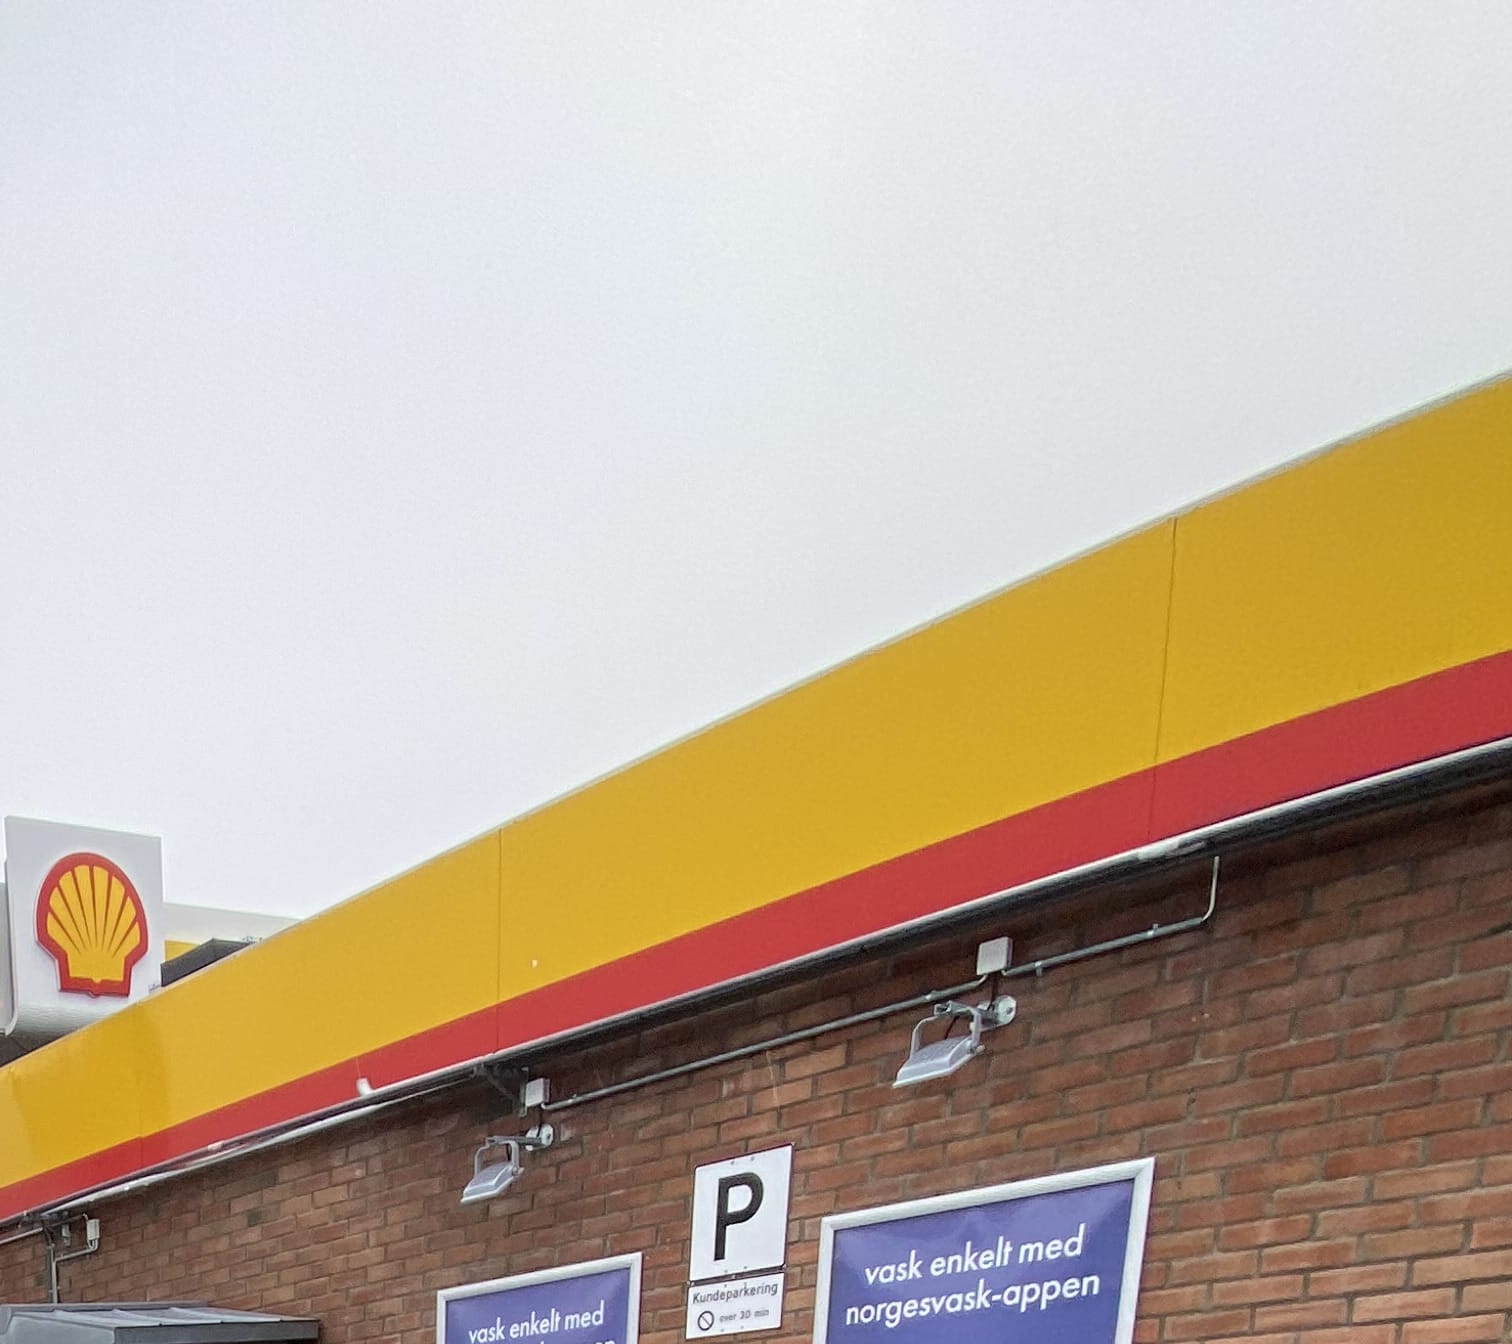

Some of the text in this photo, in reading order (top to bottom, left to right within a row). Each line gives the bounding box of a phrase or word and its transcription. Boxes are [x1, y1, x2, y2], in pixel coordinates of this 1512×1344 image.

[713, 1172, 764, 1261] P
[864, 1223, 1087, 1286] vask enkelt med
[692, 1282, 779, 1305] Kundeparkering
[845, 1275, 1100, 1328] norgesvask-appen
[468, 1299, 605, 1344] vask enkelt med
